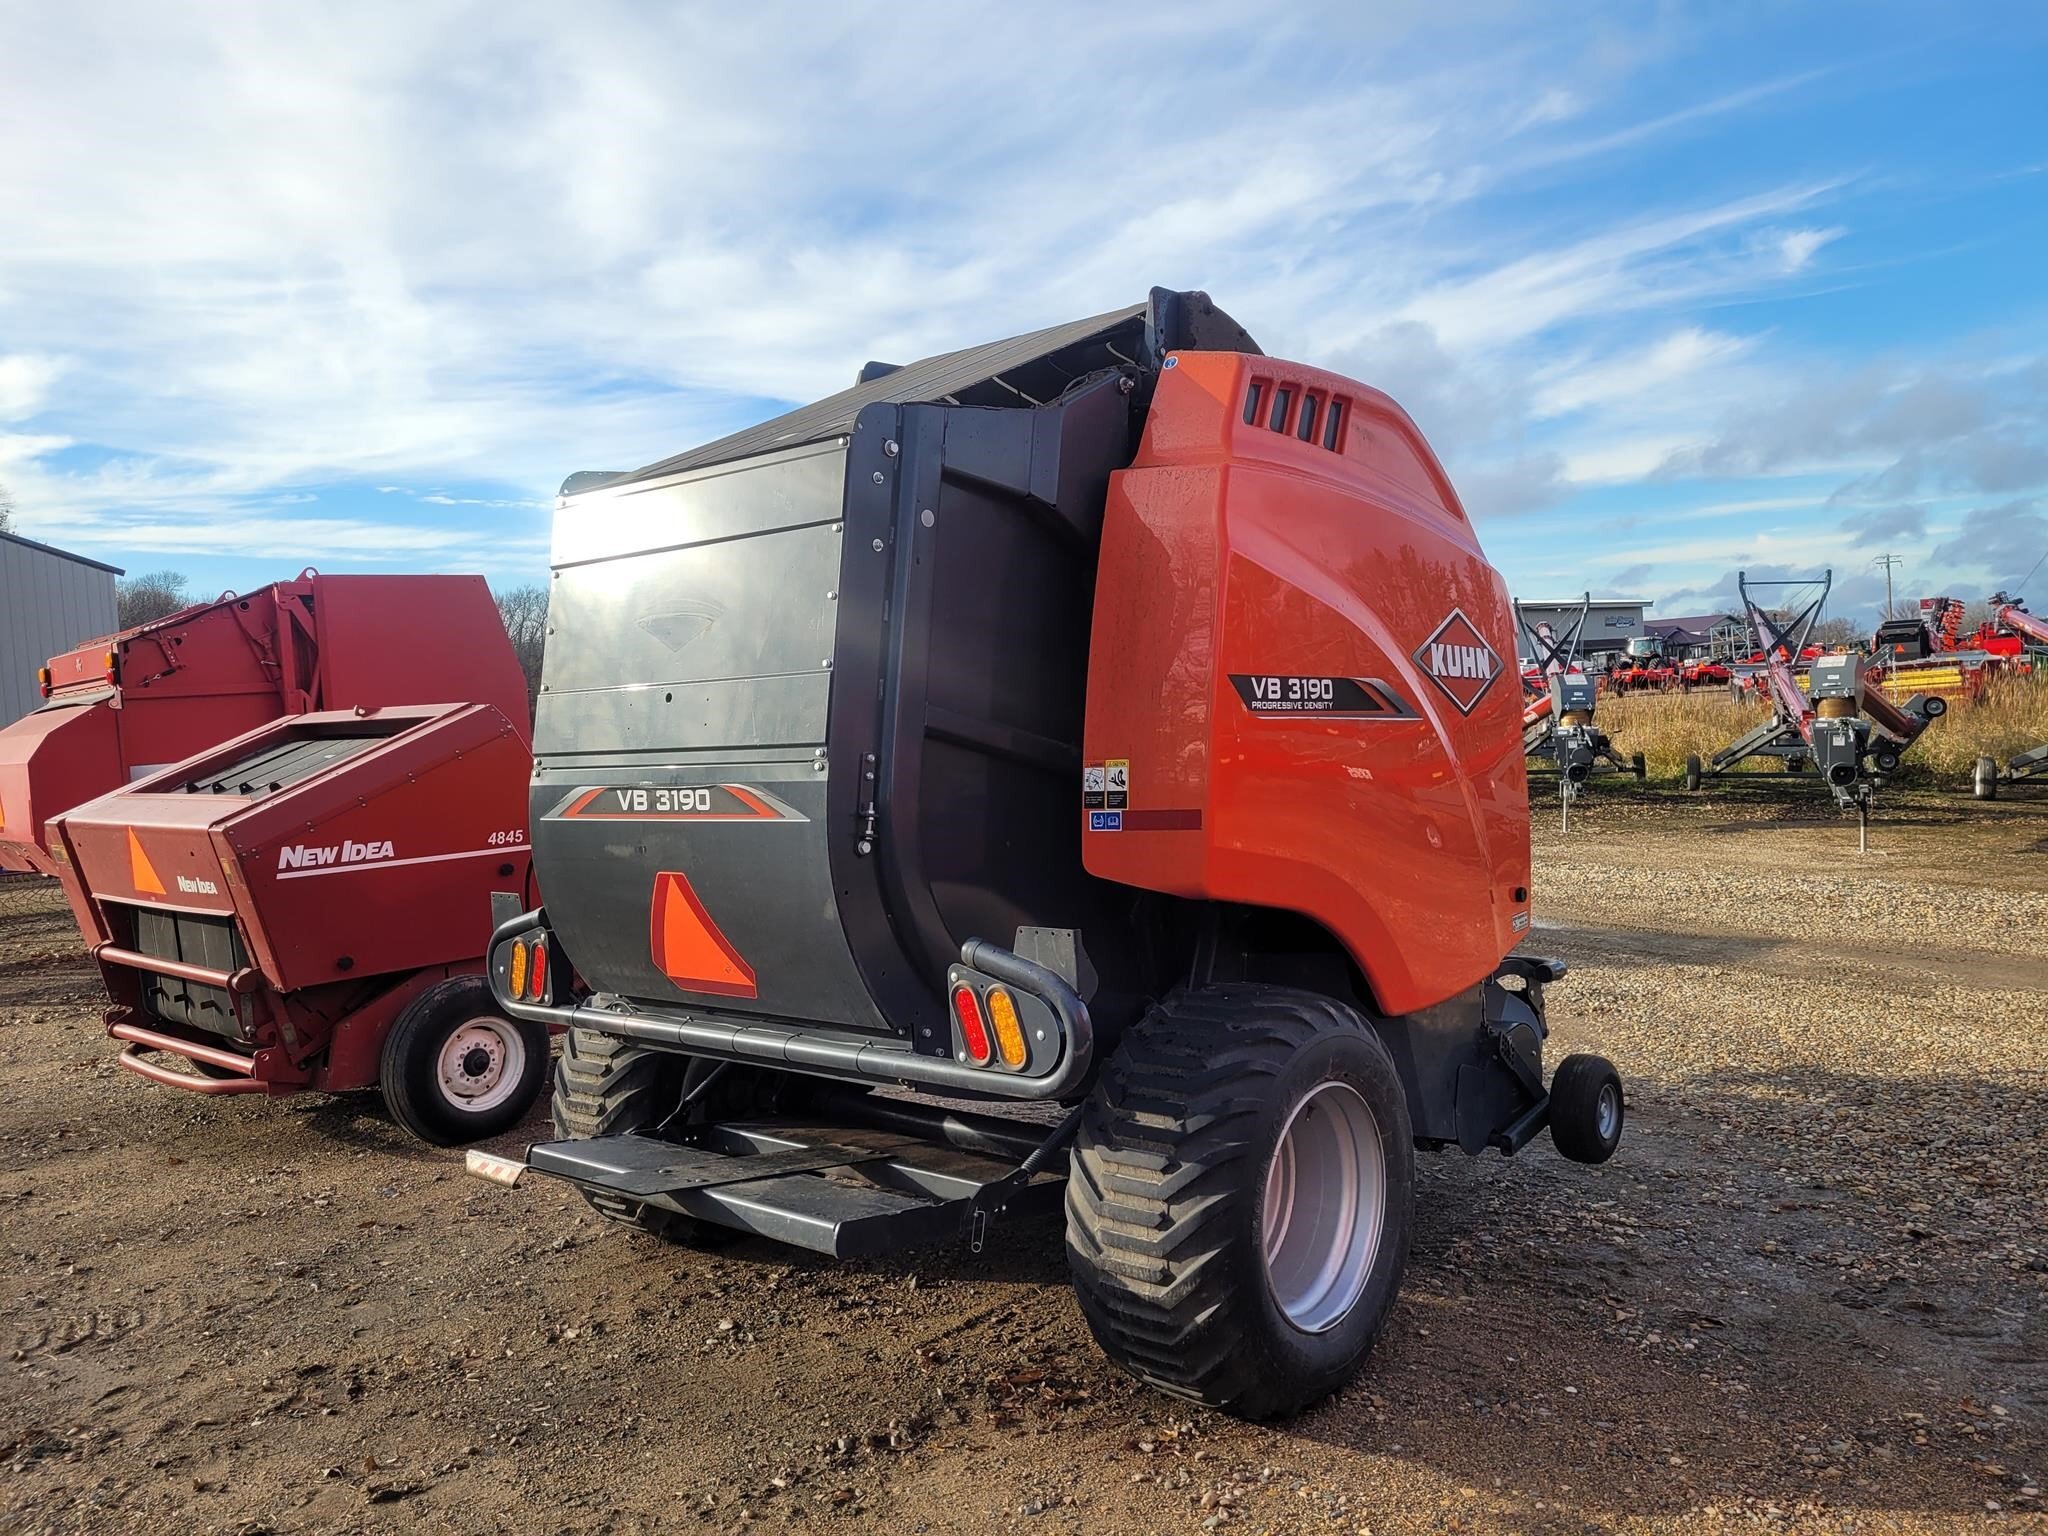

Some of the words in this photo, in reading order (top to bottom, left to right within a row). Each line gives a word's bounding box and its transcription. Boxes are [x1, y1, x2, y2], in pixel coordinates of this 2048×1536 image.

[1430, 643, 1491, 679] KUHN
[1251, 677, 1281, 699] VB
[1288, 678, 1333, 700] 3190
[1251, 701, 1303, 710] PROGRESSIVE
[1304, 701, 1334, 710] DENSITY
[616, 789, 648, 811] VB
[655, 788, 711, 811] 3190
[487, 829, 523, 846] 4845
